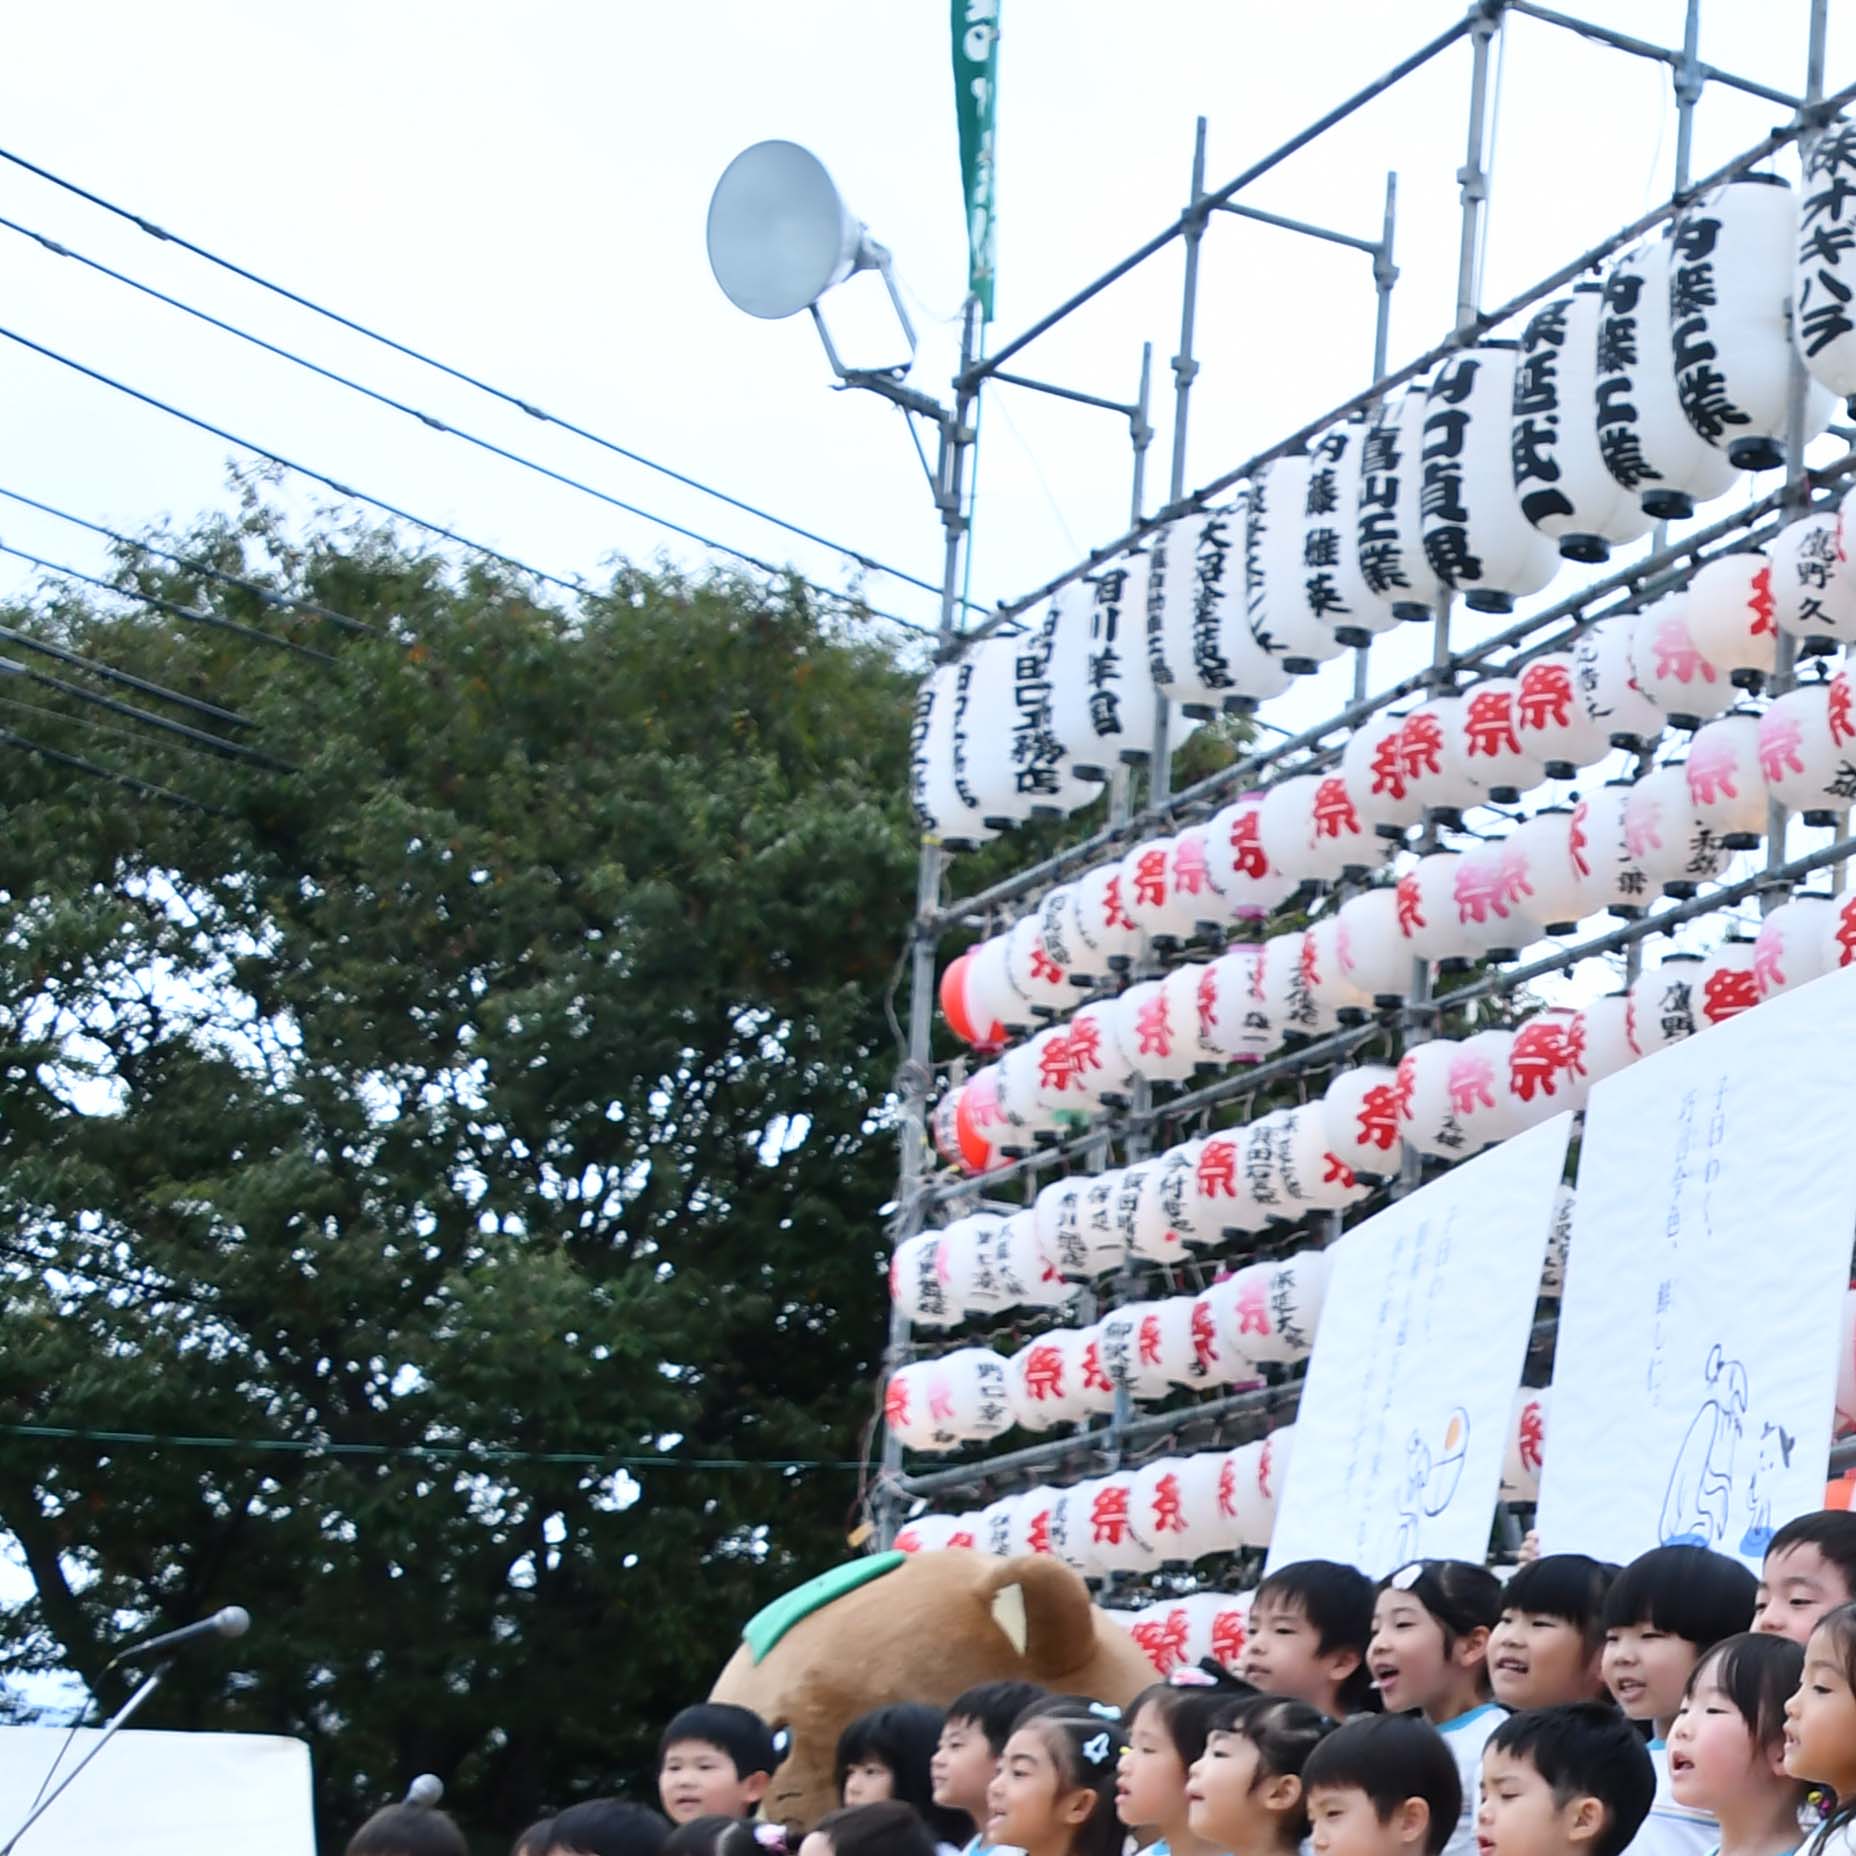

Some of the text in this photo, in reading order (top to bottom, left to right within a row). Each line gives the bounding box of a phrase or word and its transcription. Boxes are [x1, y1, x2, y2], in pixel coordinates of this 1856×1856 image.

[1465, 693, 1521, 757] 祭
[1518, 665, 1572, 730] 祭
[1314, 780, 1360, 837] 祭
[1198, 1142, 1236, 1198] 祭
[1025, 1347, 1064, 1401] 祭
[1091, 1488, 1128, 1545] 祭
